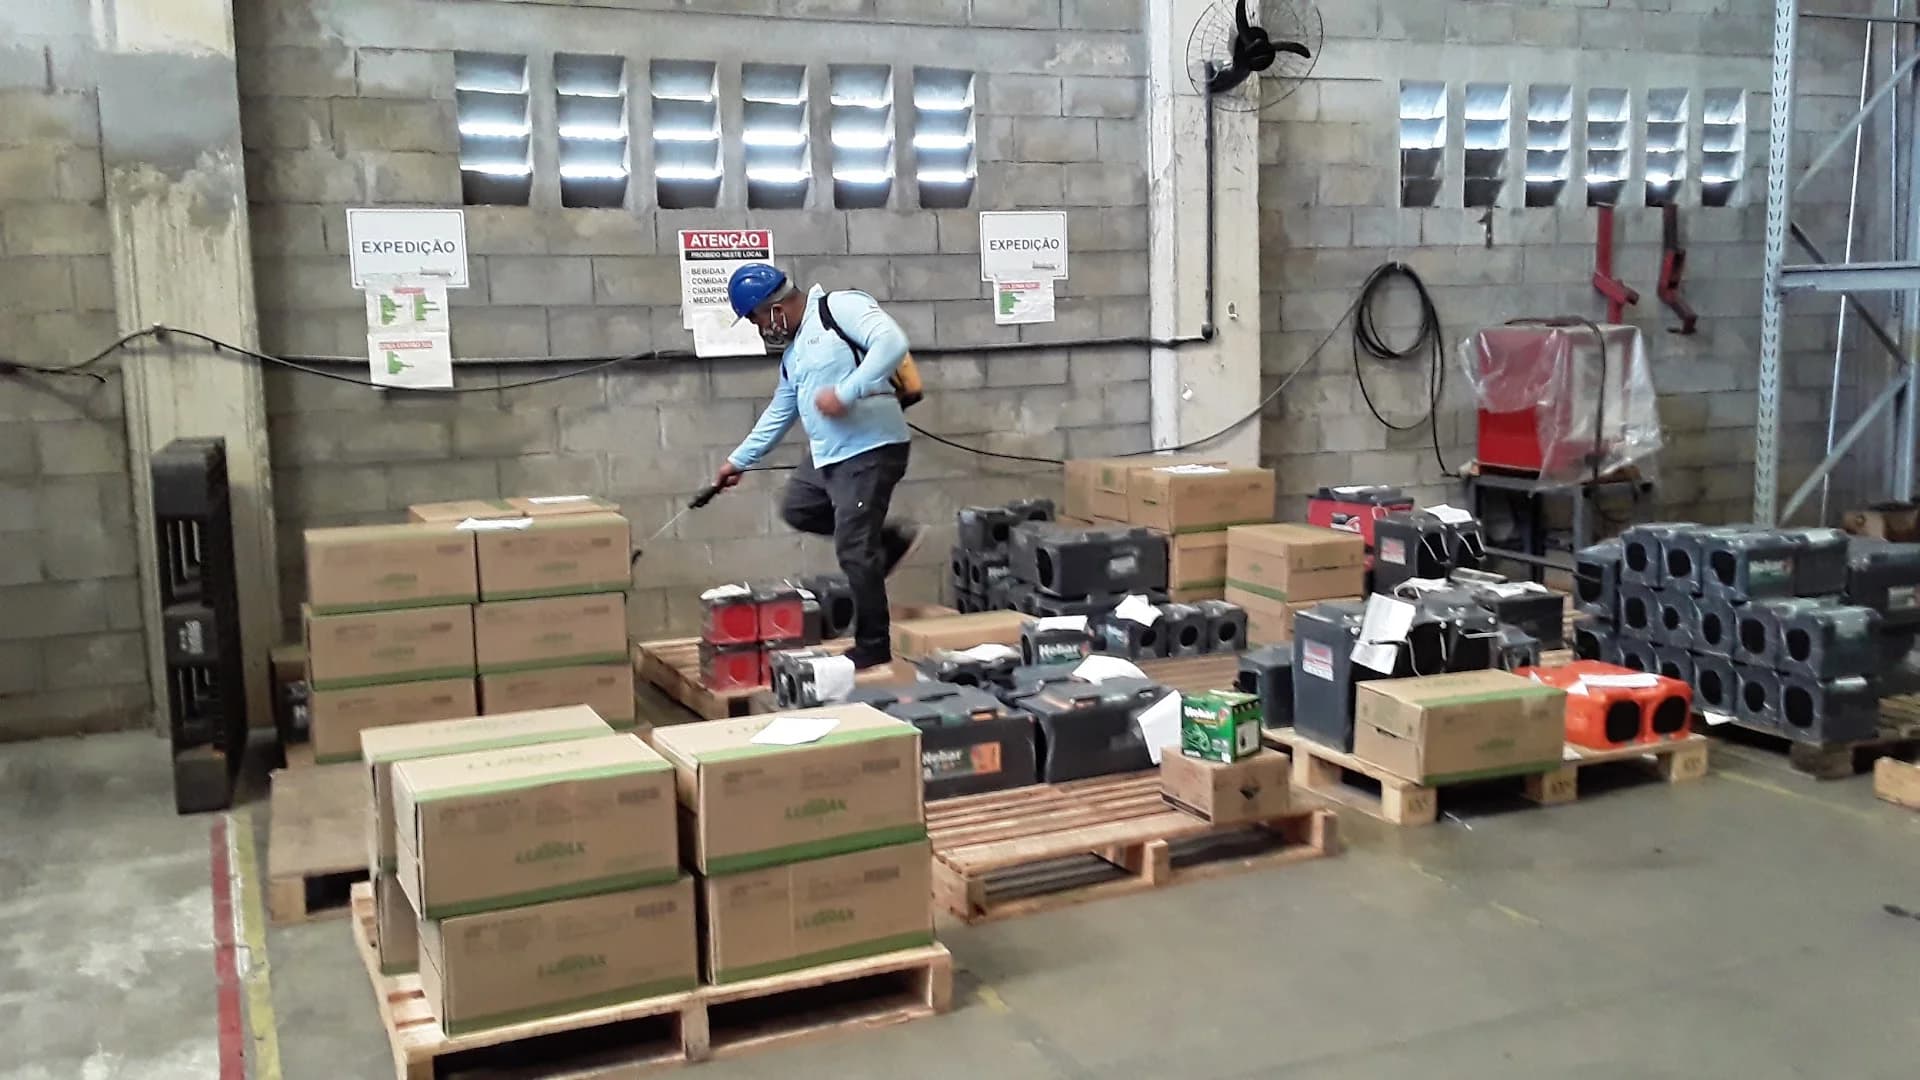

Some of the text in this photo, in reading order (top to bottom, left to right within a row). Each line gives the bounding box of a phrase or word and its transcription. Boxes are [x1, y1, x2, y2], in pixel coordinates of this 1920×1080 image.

[690, 231, 761, 249] ATENÇÃO
[989, 237, 1061, 251] EXPEDIÇÃO
[361, 238, 456, 255] EXPEDIÇÃO
[690, 251, 721, 259] PROIBIDO
[690, 267, 726, 275] BEBIDAS
[691, 277, 728, 285] COMIDAS
